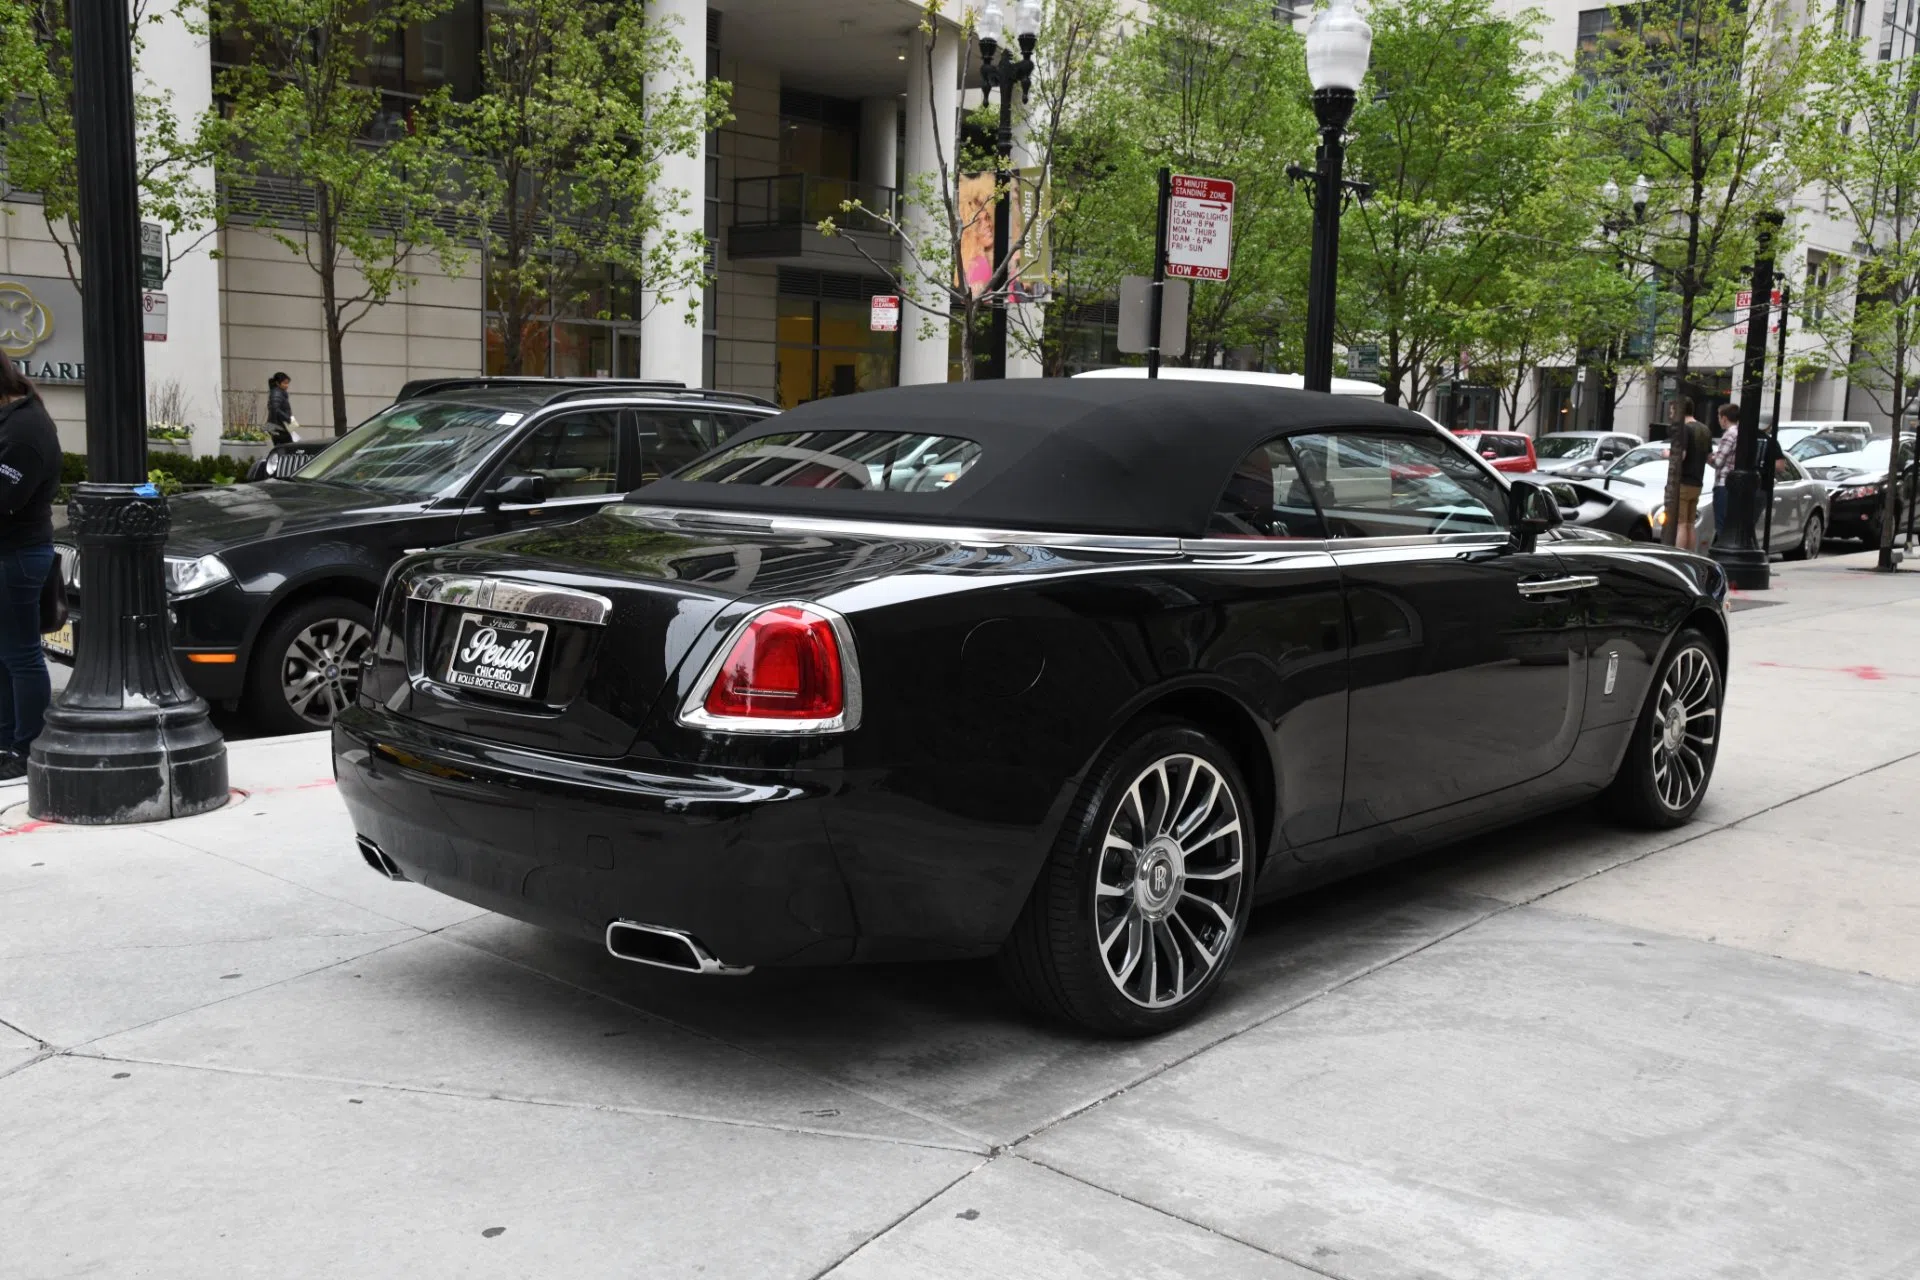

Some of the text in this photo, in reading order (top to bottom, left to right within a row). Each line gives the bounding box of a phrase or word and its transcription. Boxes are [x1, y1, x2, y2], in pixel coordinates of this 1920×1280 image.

[1175, 178, 1208, 190] 15 MINUTE
[1175, 187, 1226, 200] STANDING ZONE
[1174, 209, 1228, 222] FLASHING LIGHTS
[1194, 227, 1216, 237] THURS
[1189, 244, 1203, 252] SUN
[1170, 264, 1223, 278] TOW ZONE
[11, 360, 86, 379] LARE
[461, 628, 535, 672] Perillo
[475, 665, 512, 681] CHICAGO
[457, 674, 519, 693] ROLLS ROYCE CHICAGO
